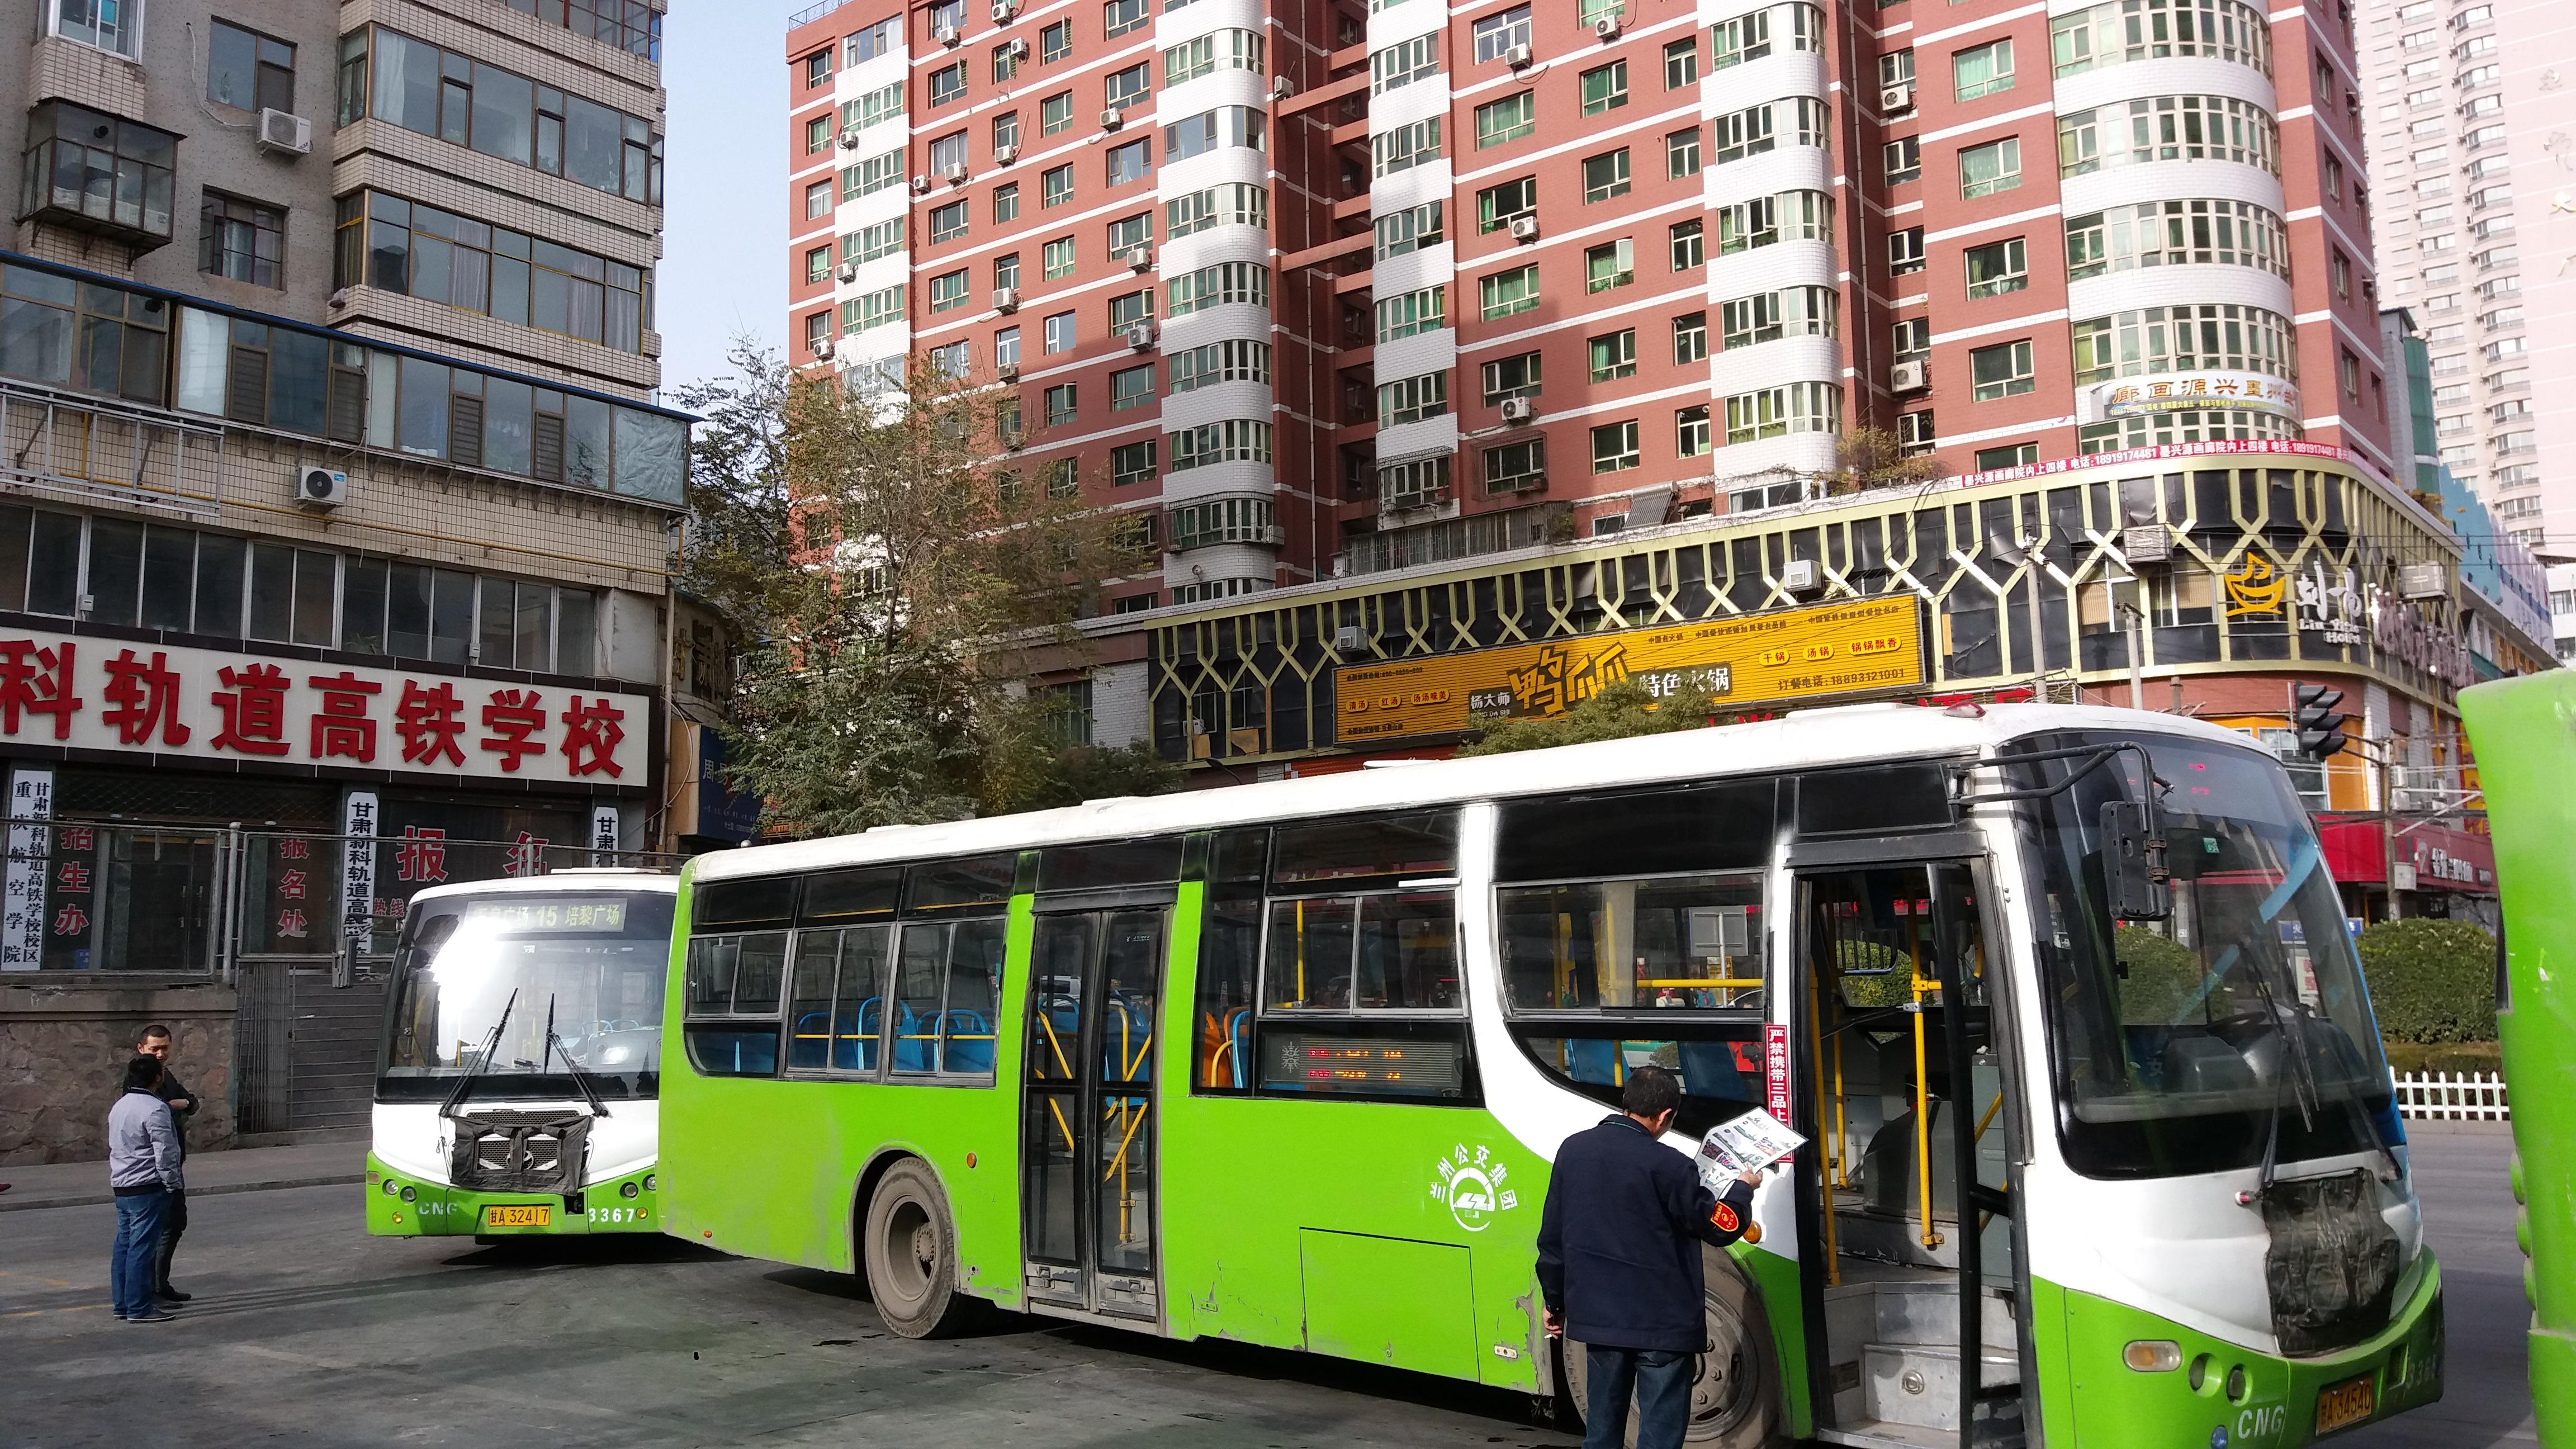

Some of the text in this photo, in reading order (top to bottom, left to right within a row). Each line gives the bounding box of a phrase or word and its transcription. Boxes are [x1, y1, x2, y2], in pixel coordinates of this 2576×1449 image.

[1763, 637, 1897, 664] 干锅 汤锅 锅锅飘香
[1638, 667, 1731, 698] 特色火锅
[1348, 690, 1447, 711] 清汤 红汤 汤汤味美
[1470, 692, 1510, 710] 杨大师
[3, 781, 32, 964] 重庆航空学院
[54, 818, 96, 936] 招生办
[277, 830, 309, 939] 报名处
[537, 905, 558, 927] 15
[565, 904, 621, 926] 培黎广场
[1429, 1143, 1518, 1211] 兰州公交集团
[418, 1202, 458, 1216] CNG
[588, 1208, 635, 1223] 3367
[2237, 1405, 2285, 1439] CNG
